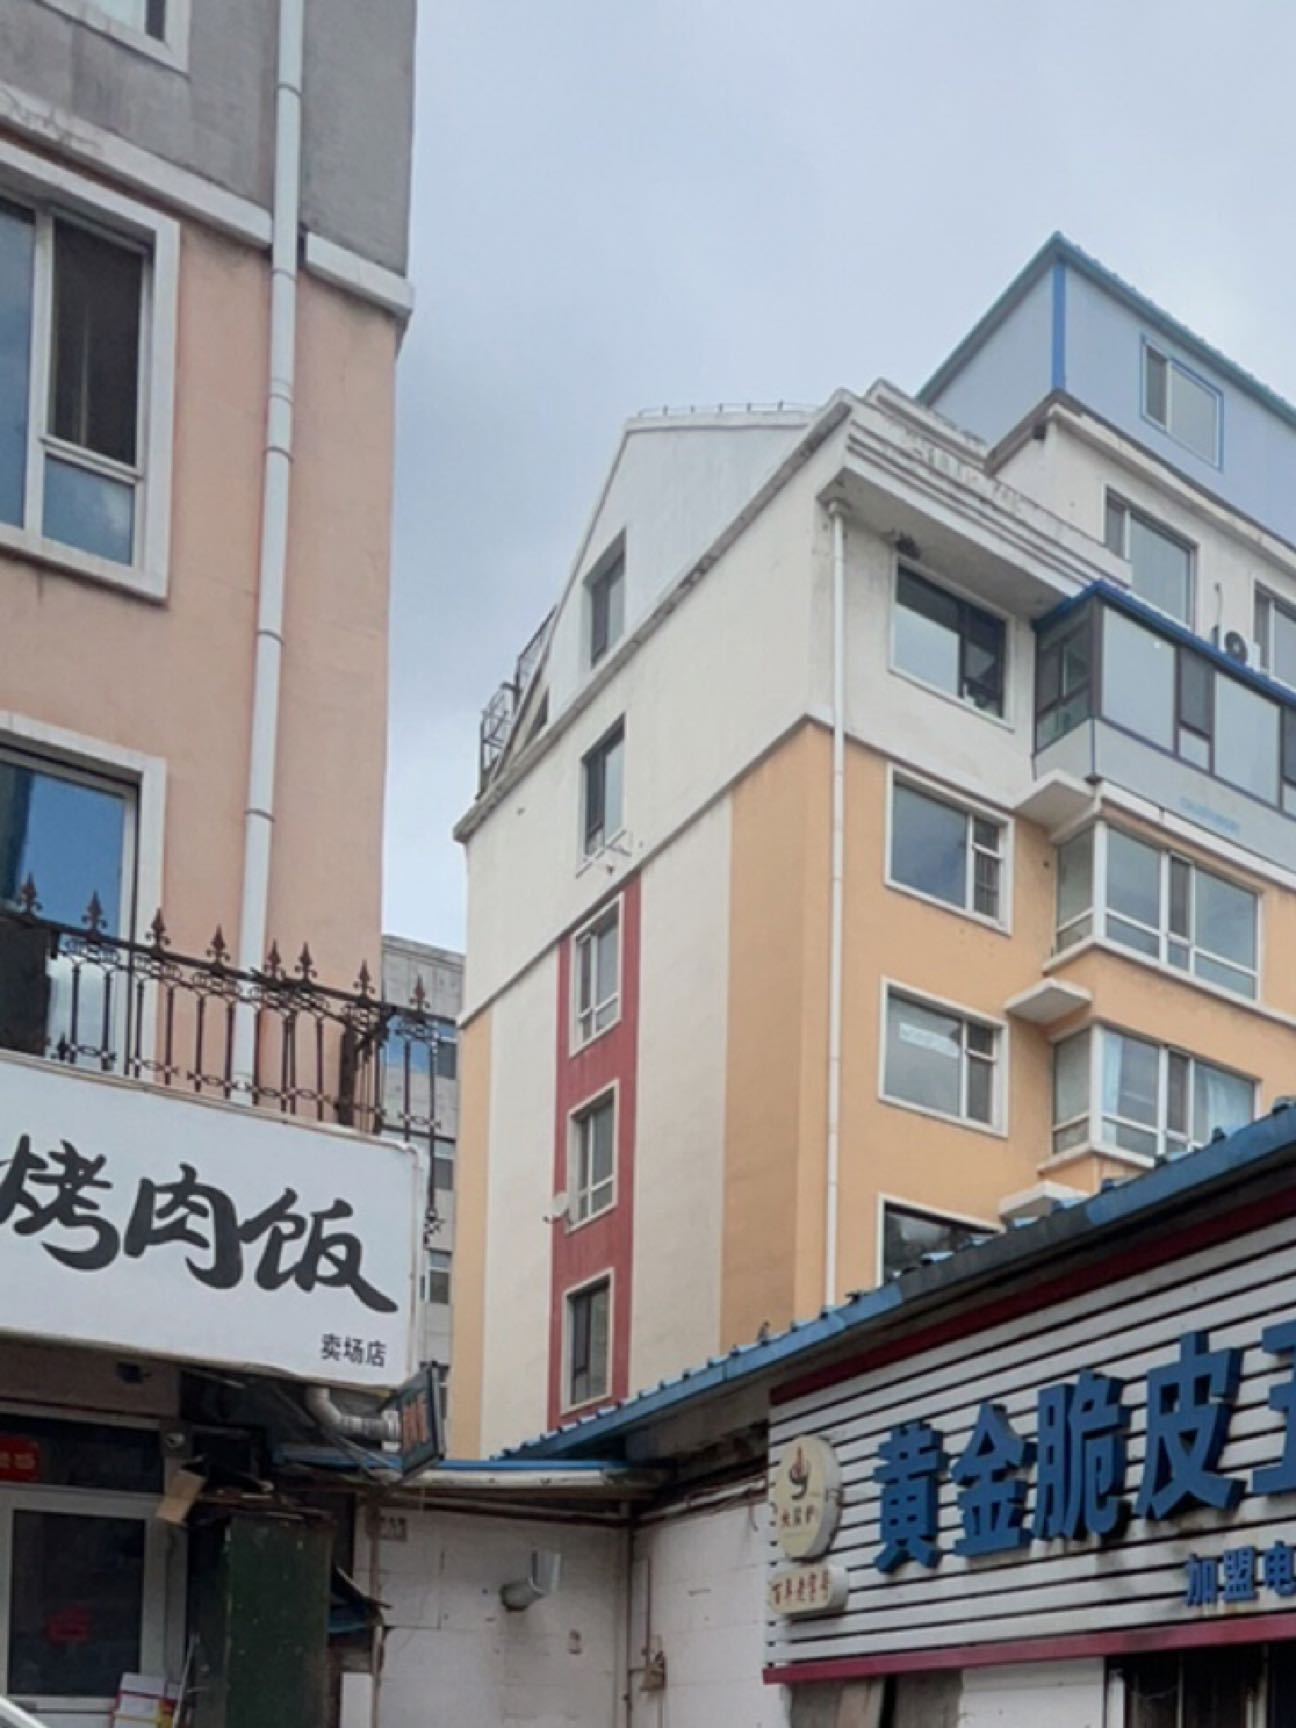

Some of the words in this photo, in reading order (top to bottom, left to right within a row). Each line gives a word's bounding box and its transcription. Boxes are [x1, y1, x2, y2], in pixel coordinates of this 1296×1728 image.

[0, 1134, 399, 1313] 烤肉饭
[321, 1333, 387, 1368] 卖场店
